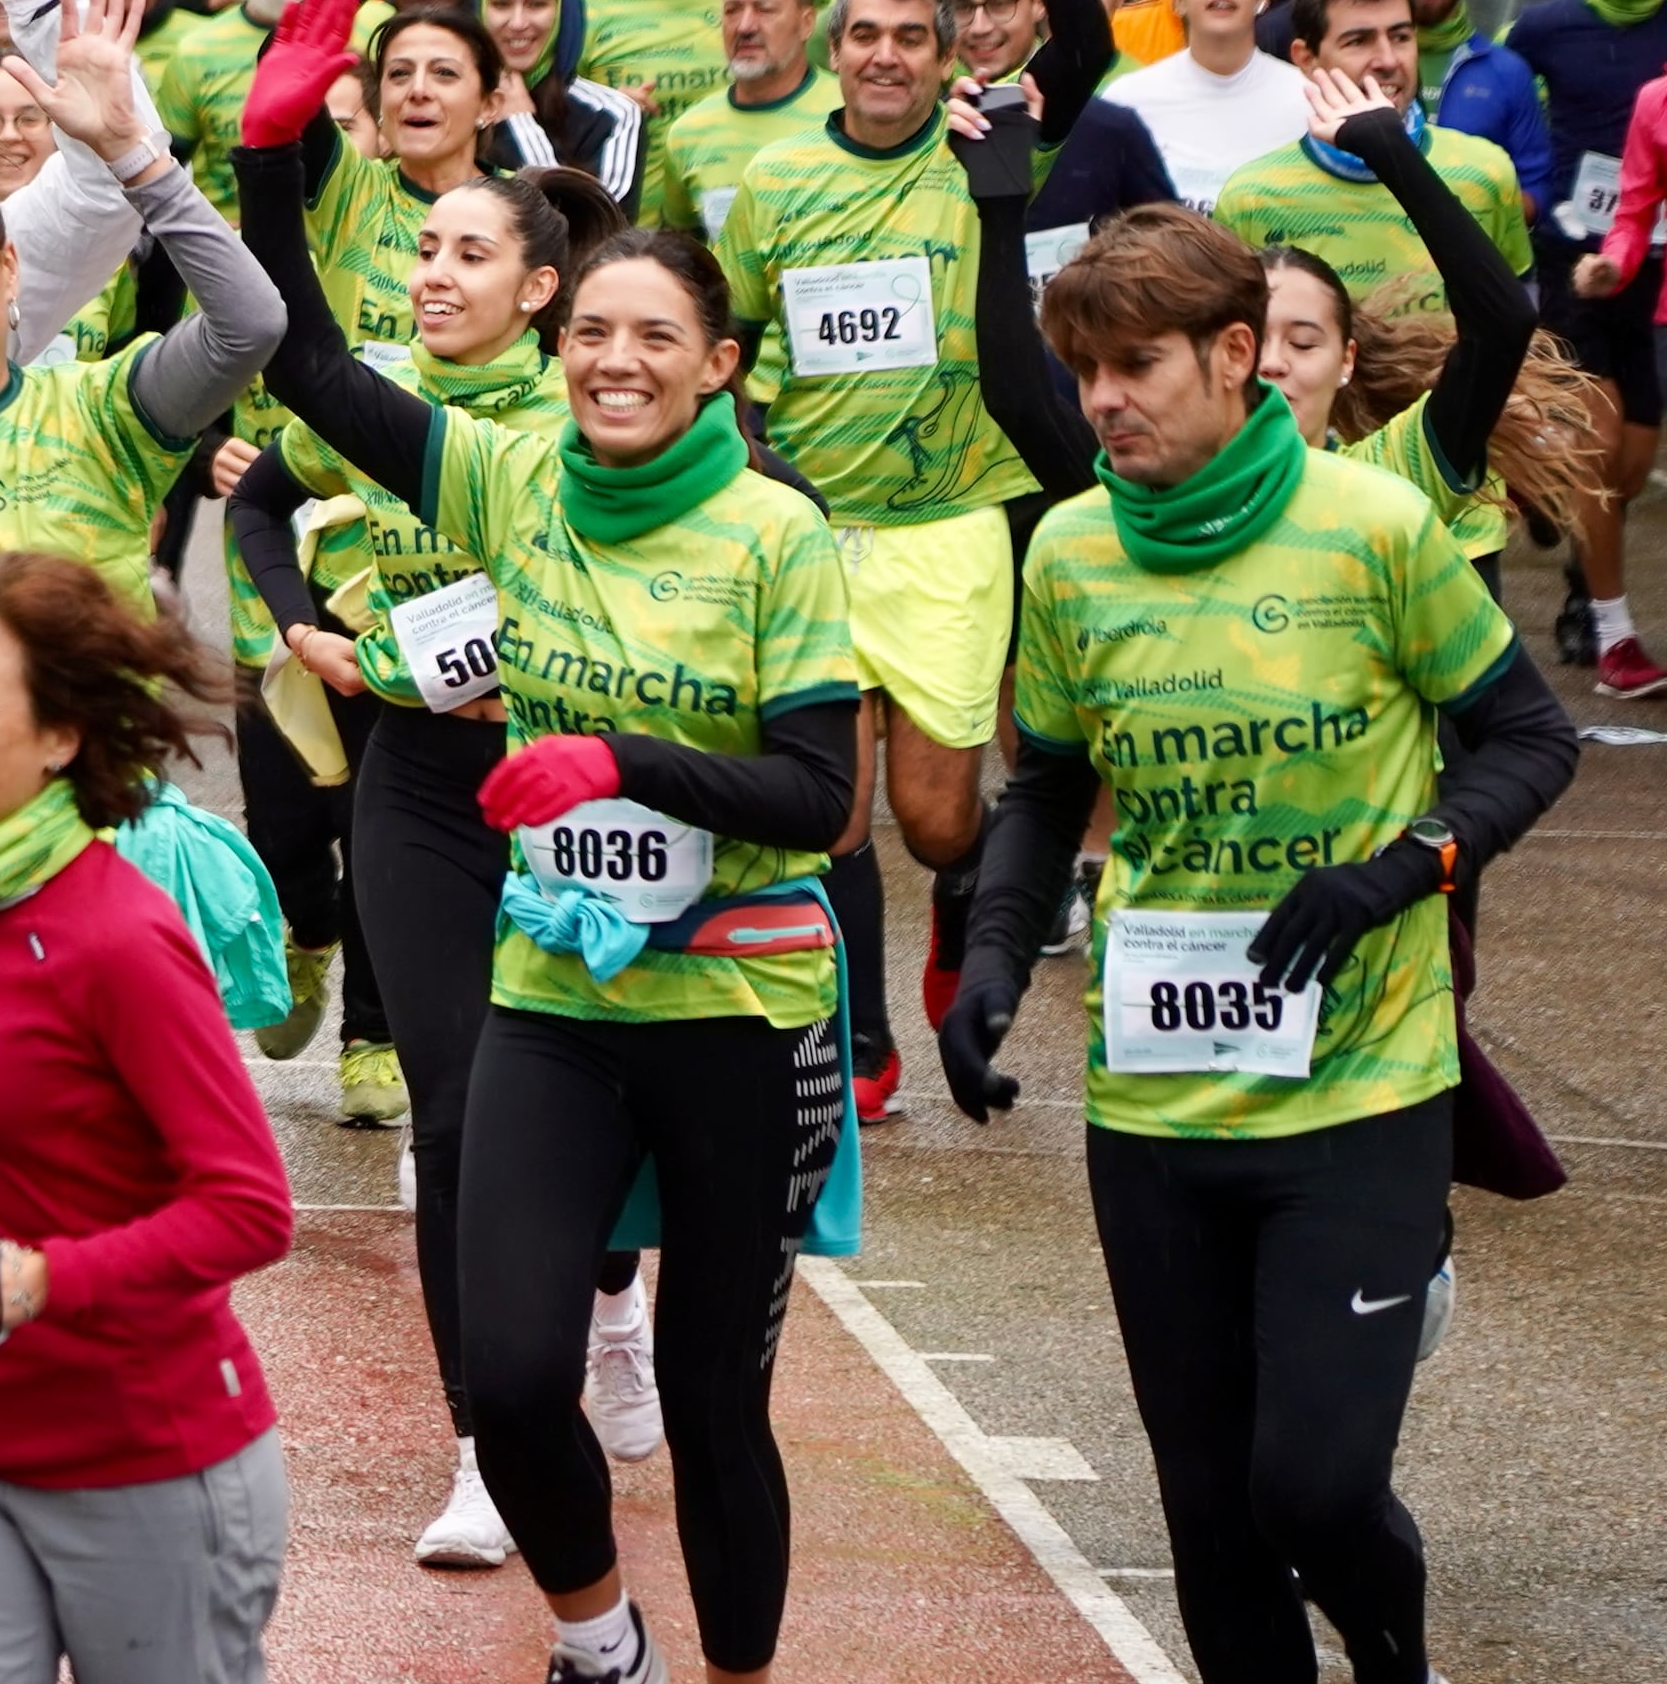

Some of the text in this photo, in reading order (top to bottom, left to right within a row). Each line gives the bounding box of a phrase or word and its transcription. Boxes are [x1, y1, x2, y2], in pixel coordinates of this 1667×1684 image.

[819, 306, 901, 346] 4692
[406, 597, 463, 624] Valladolid
[412, 617, 447, 636] contra
[449, 610, 459, 622] el
[497, 617, 738, 716] En marcha
[1114, 669, 1224, 701] Valladolid
[1152, 700, 1371, 766] marcha
[553, 827, 668, 881] 8036
[1123, 922, 1186, 938] Valladolid
[1123, 938, 1227, 952] contra el cáncer
[1150, 981, 1283, 1032] 8035
